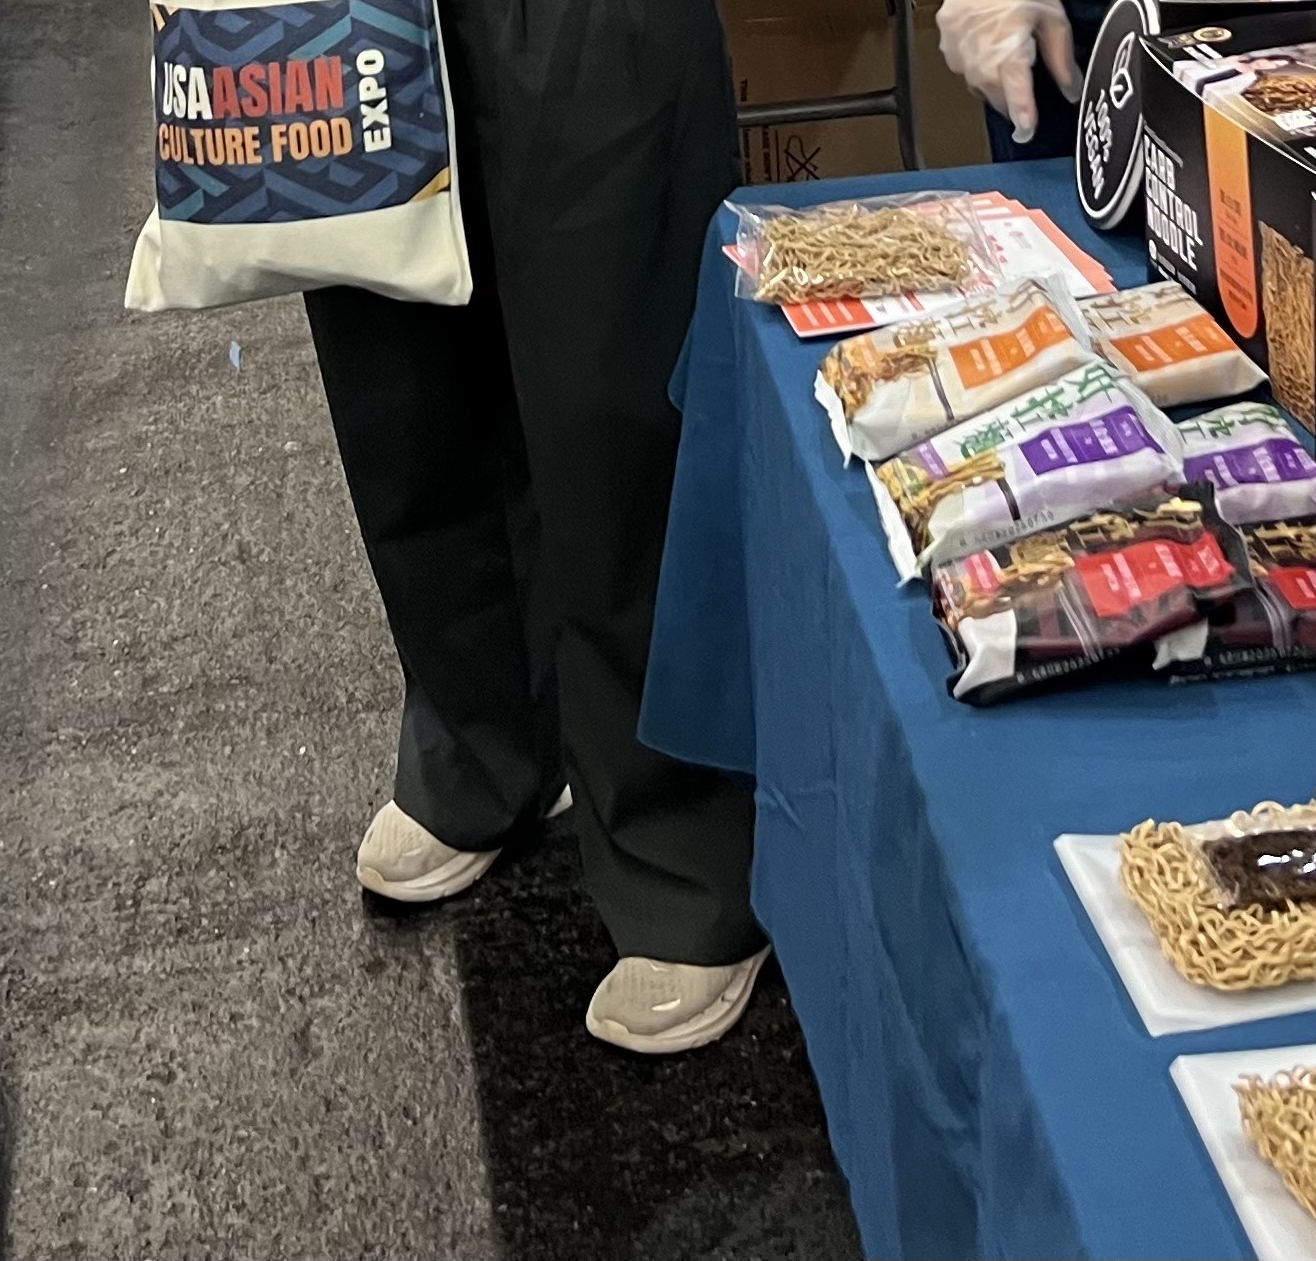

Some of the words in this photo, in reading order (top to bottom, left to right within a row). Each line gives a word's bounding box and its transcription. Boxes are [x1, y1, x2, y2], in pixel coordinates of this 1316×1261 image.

[163, 65, 213, 121] USA
[212, 55, 345, 120] ASIAN
[357, 48, 392, 153] EXPO
[159, 126, 263, 166] CULTURE
[272, 116, 353, 160] FOOD
[1143, 133, 1175, 191] CARB
[1145, 166, 1204, 246] CONTROL
[1146, 195, 1198, 272] NOODLE
